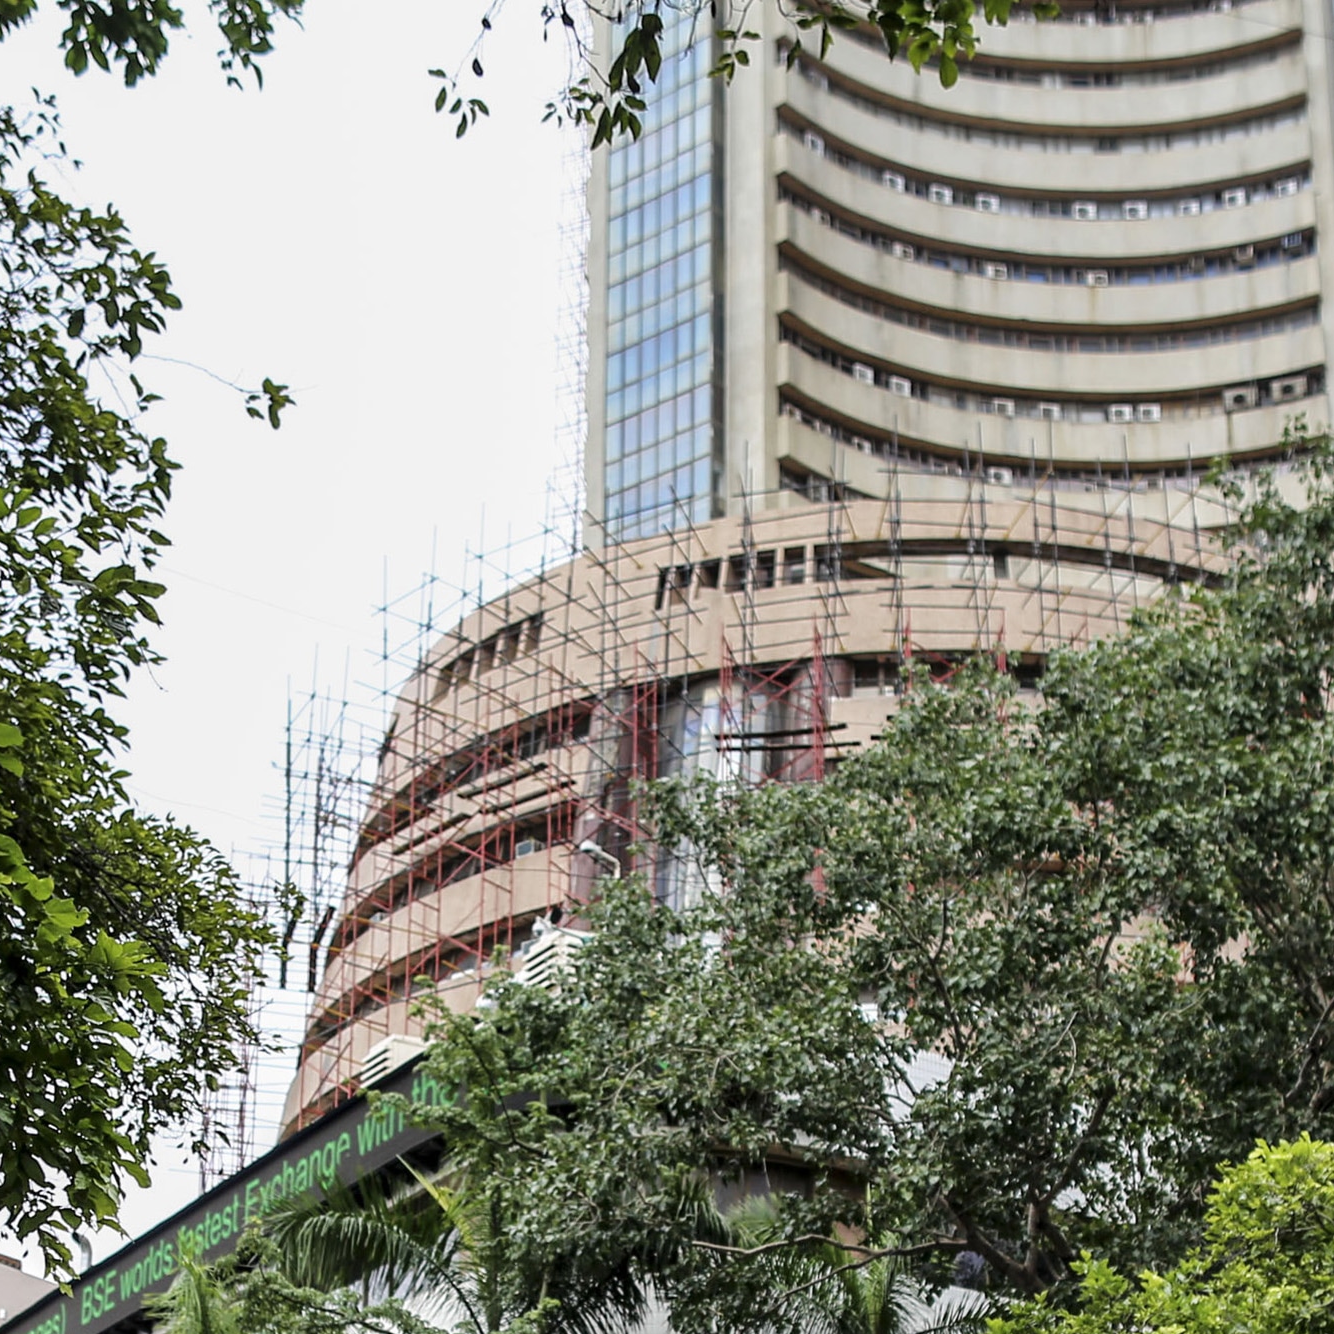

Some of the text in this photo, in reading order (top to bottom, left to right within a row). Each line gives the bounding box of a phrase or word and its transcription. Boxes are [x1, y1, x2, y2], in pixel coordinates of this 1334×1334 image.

[81, 1270, 117, 1325] BSE
[119, 1239, 174, 1301] worlds
[244, 1131, 352, 1222] Exchange
